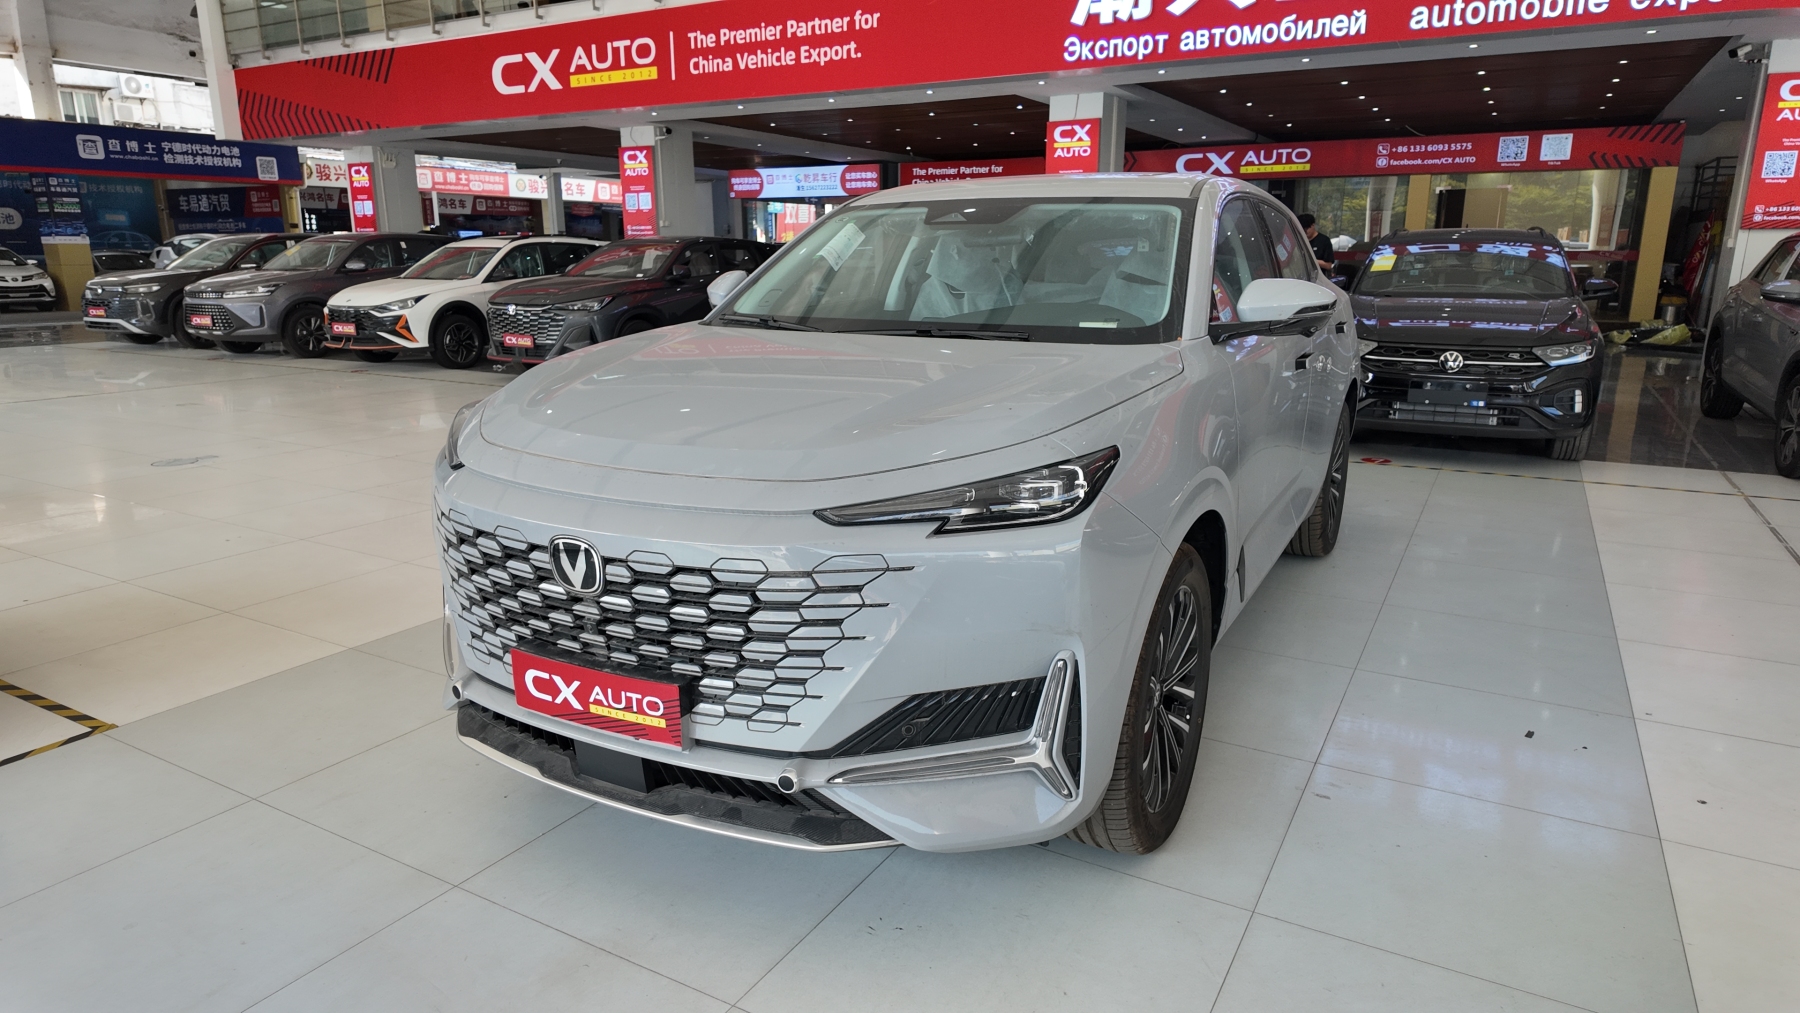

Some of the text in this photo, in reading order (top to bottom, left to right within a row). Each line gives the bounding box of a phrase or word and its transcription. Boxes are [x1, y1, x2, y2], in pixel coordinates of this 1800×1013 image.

[1409, 0, 1607, 30] automobile
[688, 11, 881, 50] The Premier Partner for
[1063, 32, 1169, 61] Экспорт
[1179, 9, 1367, 51] автомобилей
[491, 37, 657, 95] CX AUTO
[689, 41, 863, 75] China Vehicle Export.
[575, 69, 654, 85] SINCE 2012
[1780, 79, 1800, 101] C
[1053, 124, 1091, 142] CX
[107, 139, 157, 154] 查博士
[161, 141, 240, 157] 宁德时代动力电池
[1053, 146, 1091, 158] AUTO
[1391, 142, 1473, 154] +86 133 6093 5575
[163, 153, 242, 168] 检测技术授权机构
[623, 150, 647, 164] CX
[1175, 148, 1312, 175] CX AUTO
[1389, 155, 1476, 166] facebook.com/CX AUTO
[351, 166, 368, 178] CX
[625, 168, 648, 176] AUTO
[912, 164, 1003, 176] The Premier Partner for
[353, 180, 369, 188] AUTO
[178, 194, 231, 213] 车易通汽贸
[333, 324, 343, 332] CX
[505, 336, 517, 344] CX
[524, 668, 664, 716] CX AUTO
[595, 707, 662, 726] SINCE 2012
